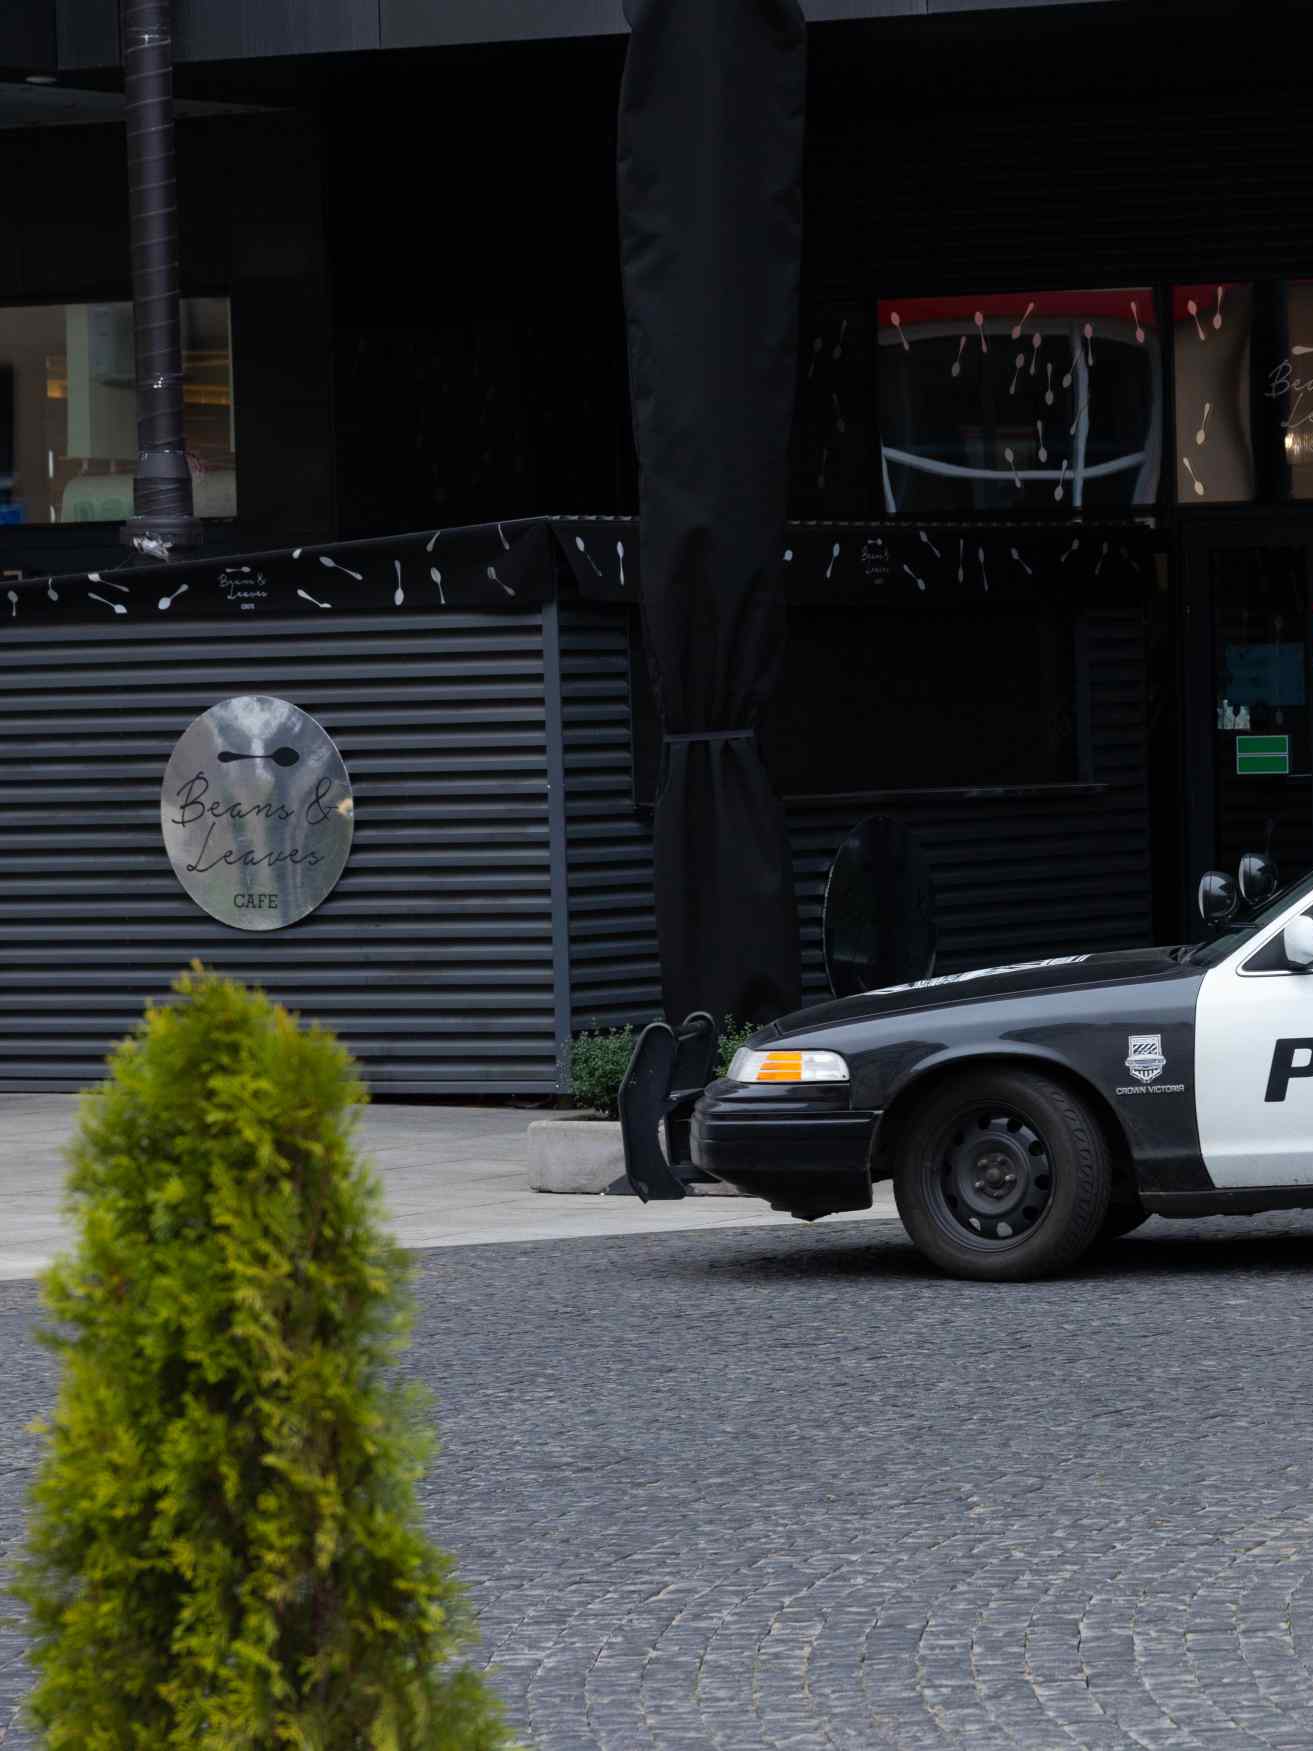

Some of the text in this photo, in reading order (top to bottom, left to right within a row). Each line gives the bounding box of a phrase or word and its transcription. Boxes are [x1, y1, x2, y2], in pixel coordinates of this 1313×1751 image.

[171, 771, 339, 827] Beans &
[186, 821, 325, 873] Leaves
[233, 893, 279, 909] CAFE
[1115, 1084, 1184, 1096] CROWN VICTORIA
